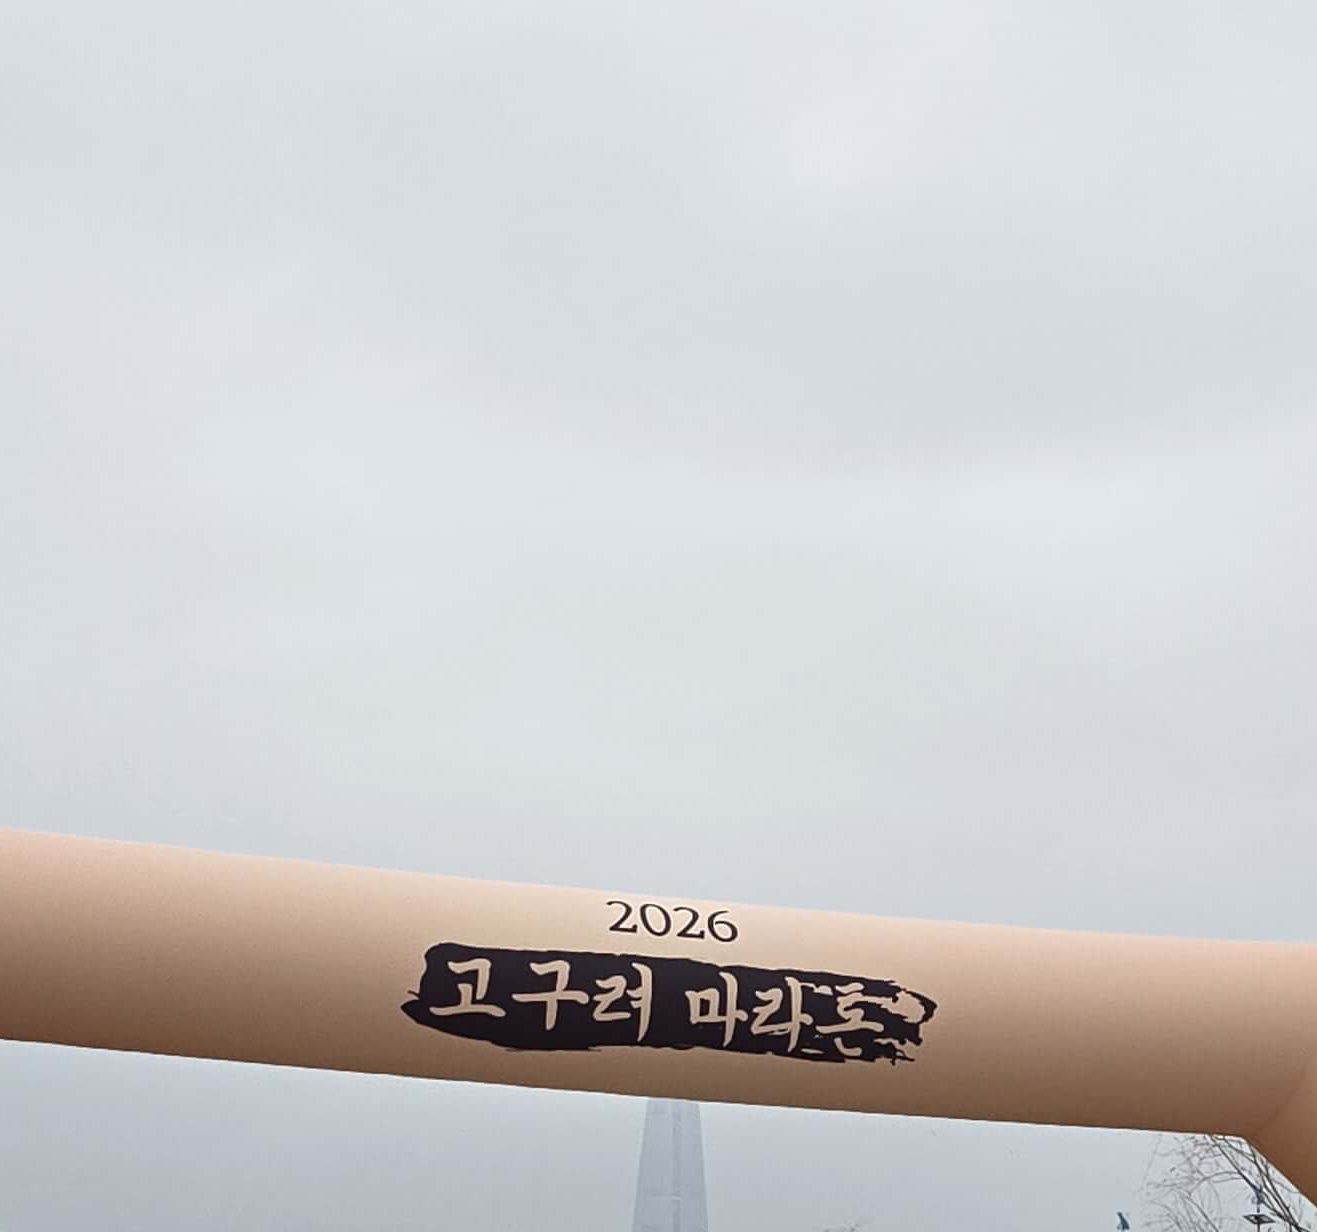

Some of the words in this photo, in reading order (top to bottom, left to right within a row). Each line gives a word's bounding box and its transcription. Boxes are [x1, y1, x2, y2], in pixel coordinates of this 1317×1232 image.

[605, 900, 739, 943] 2026
[429, 958, 653, 1043] 고구려
[685, 971, 930, 1057] 마라톤
